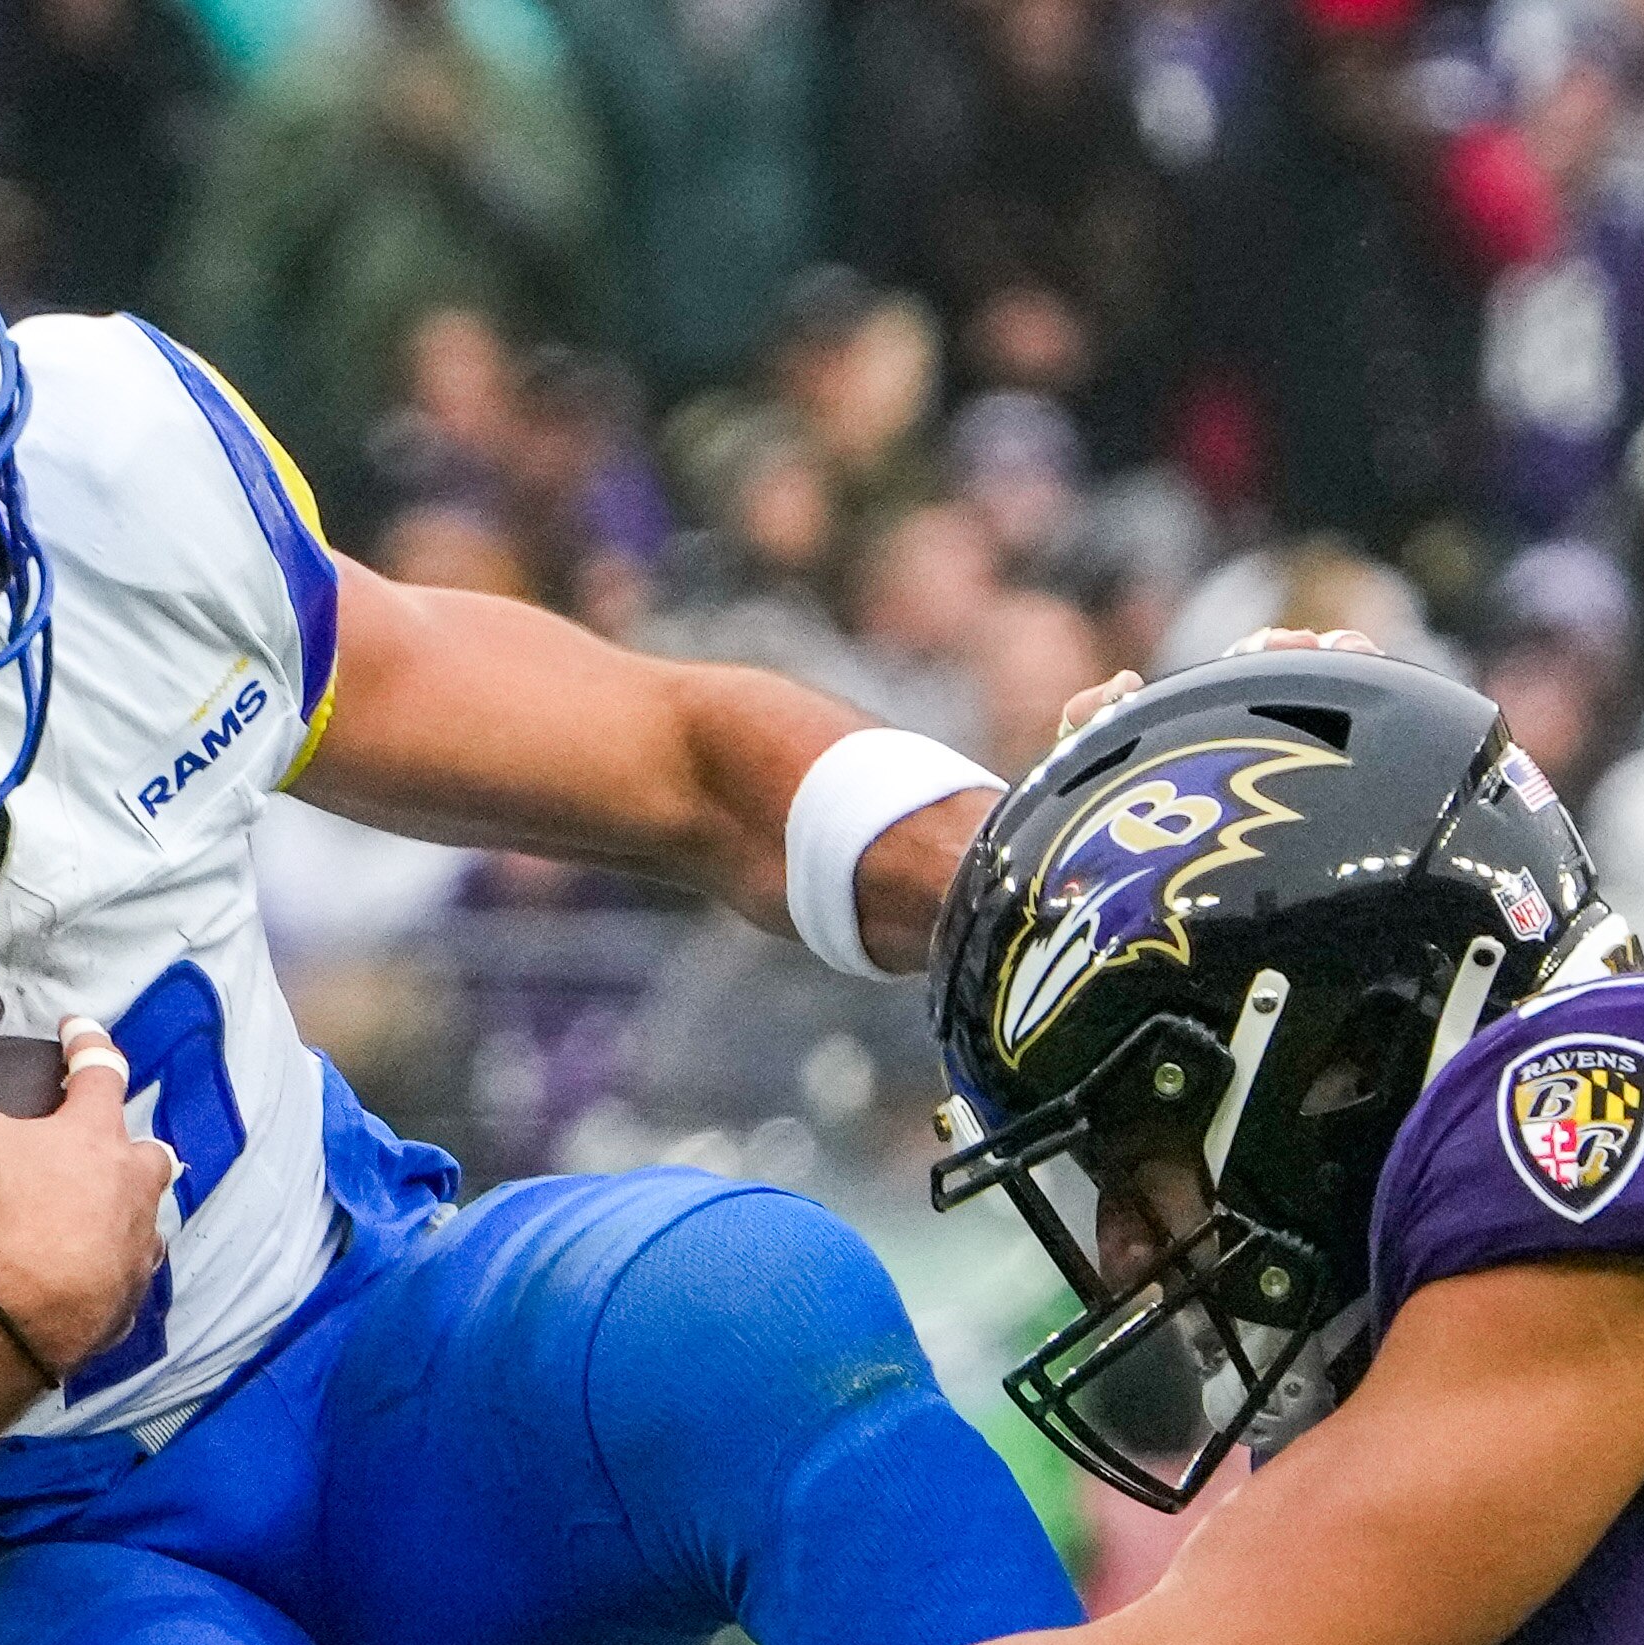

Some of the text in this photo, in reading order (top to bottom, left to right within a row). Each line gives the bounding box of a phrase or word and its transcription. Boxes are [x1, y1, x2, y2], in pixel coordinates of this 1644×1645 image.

[138, 680, 268, 818] RAMS
[1058, 779, 1223, 871] B
[1510, 896, 1547, 932] NFL
[1518, 1051, 1638, 1082] RAVENS
[1521, 1075, 1582, 1124] B
[1575, 1121, 1630, 1174] R
